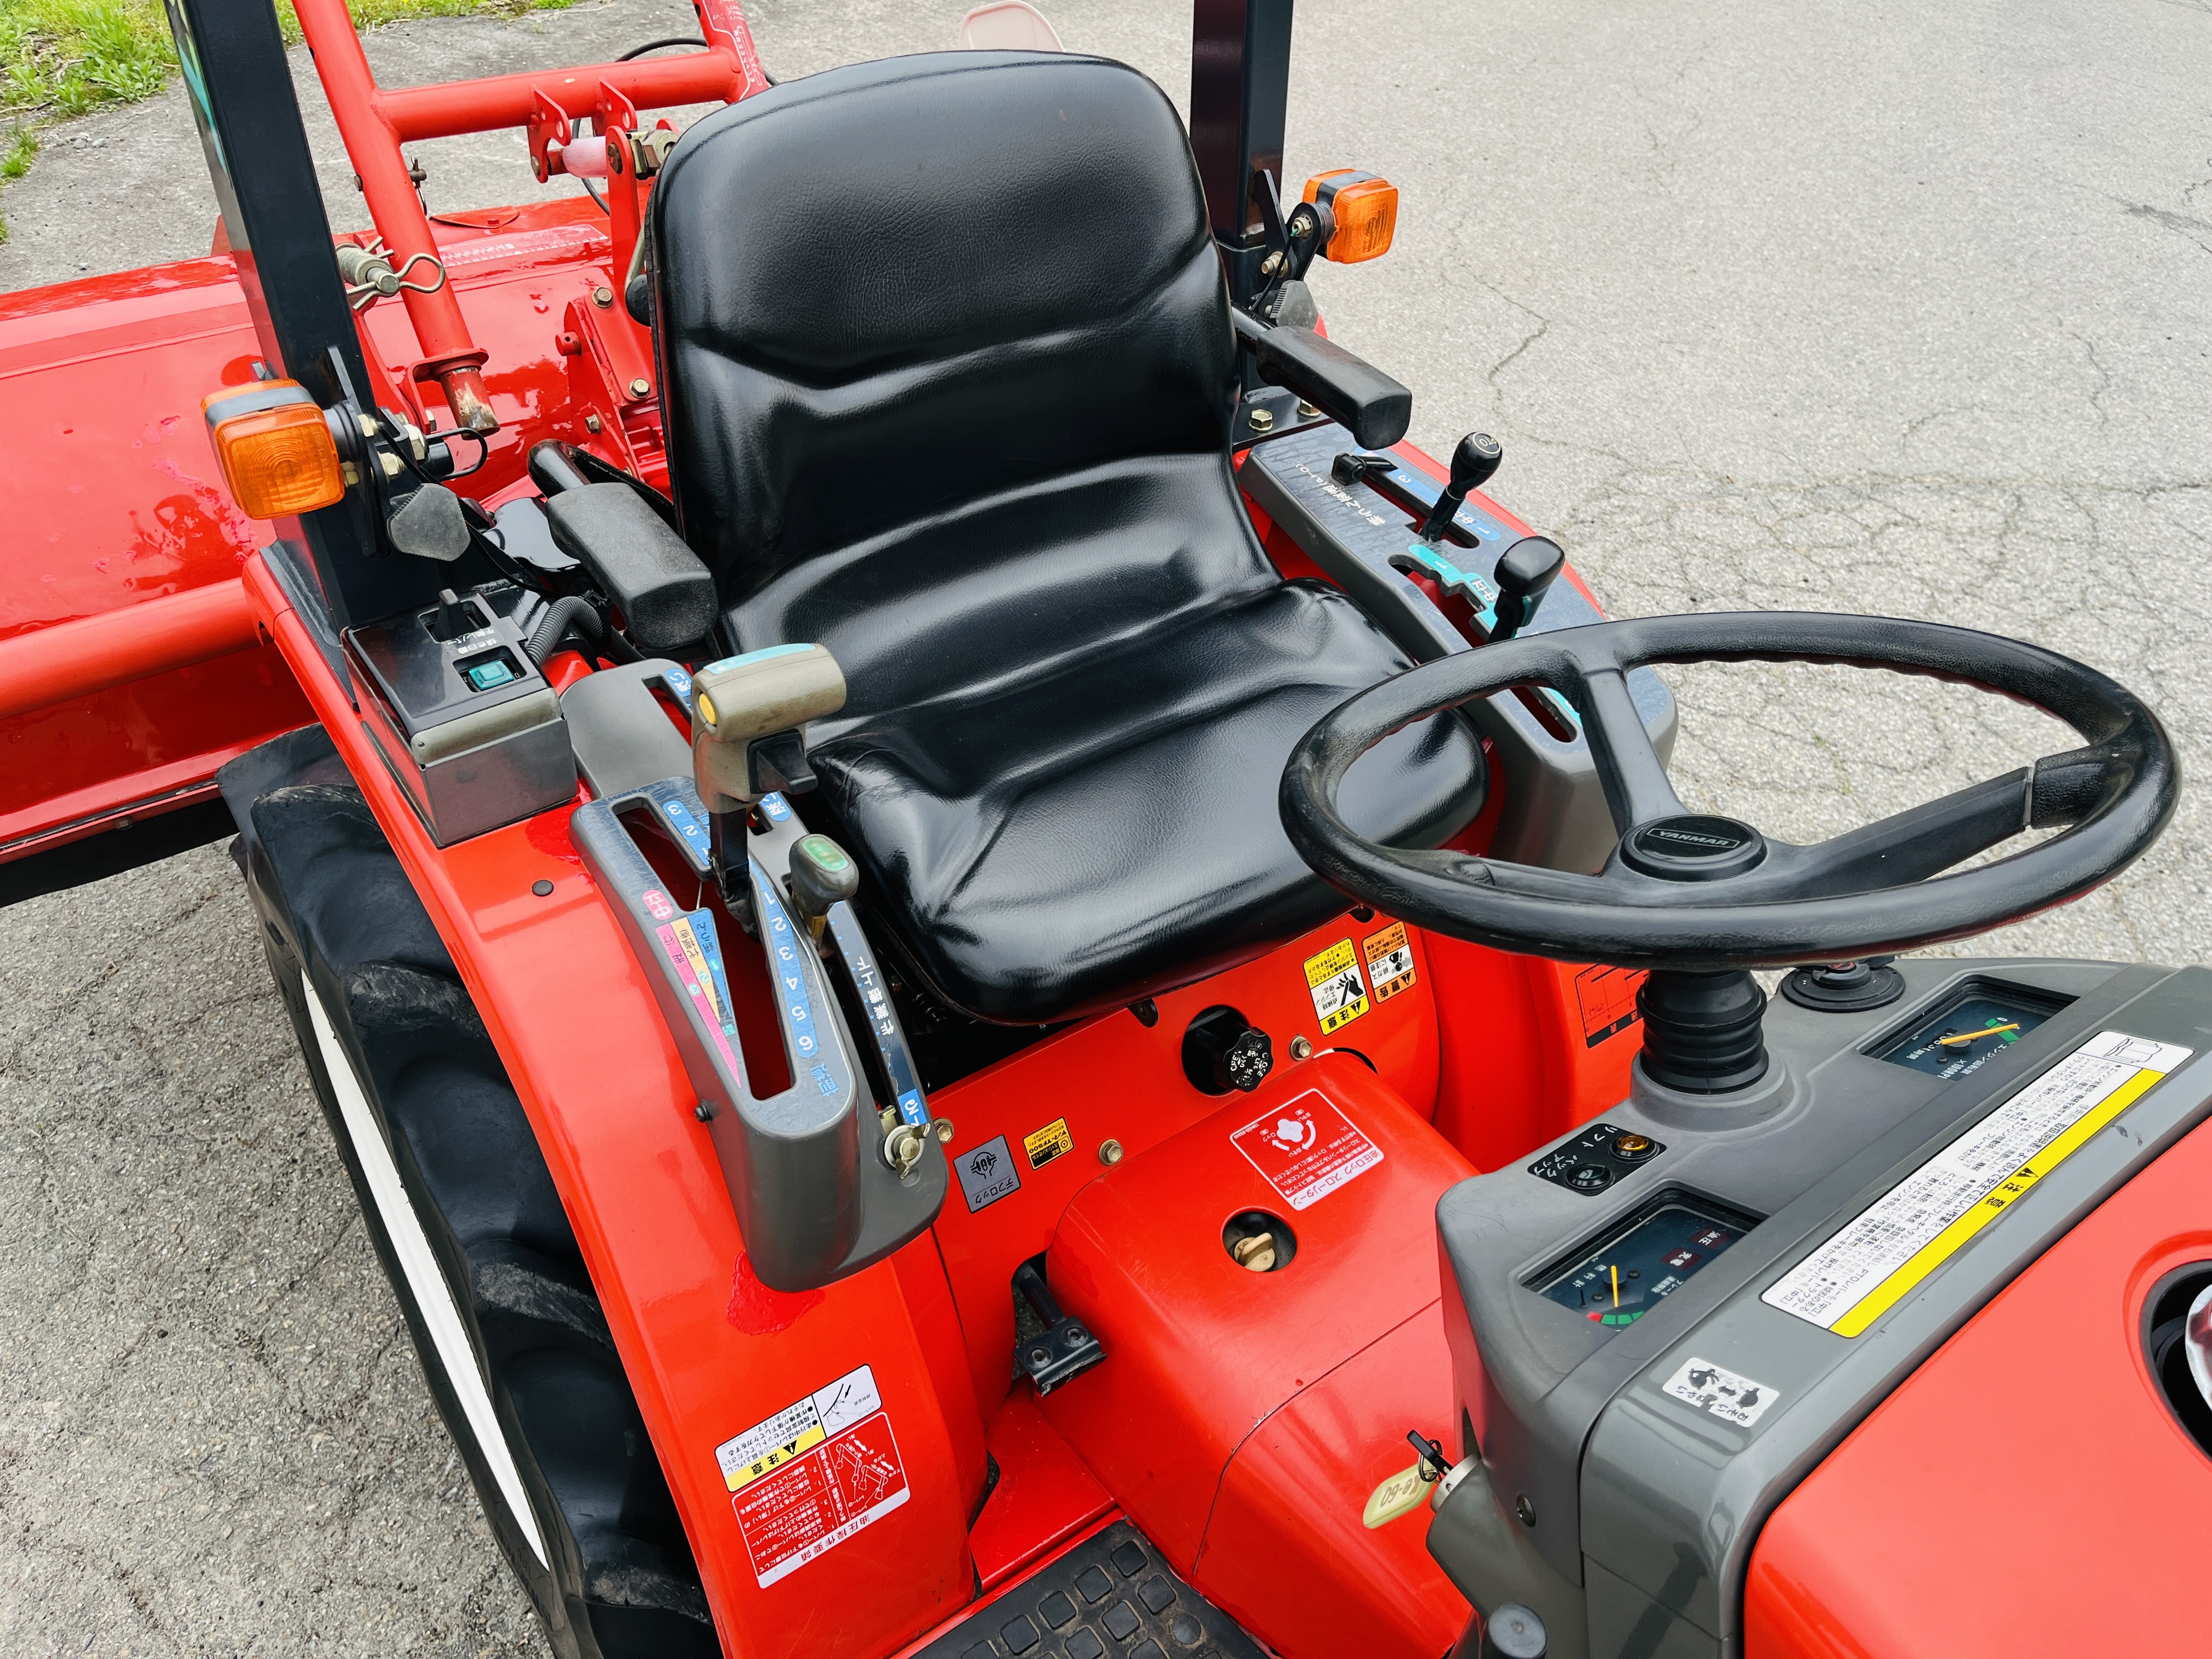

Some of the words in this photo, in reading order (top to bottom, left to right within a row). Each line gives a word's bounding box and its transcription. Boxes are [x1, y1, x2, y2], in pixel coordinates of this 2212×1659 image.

[1479, 436, 1497, 447] PTO
[668, 804, 682, 815] 3
[682, 825, 698, 836] 2
[1659, 830, 1730, 847] YANMAR
[644, 892, 671, 918] 中立
[764, 892, 775, 905] 1
[771, 917, 787, 931] 2
[778, 946, 794, 961] 3
[1369, 958, 1386, 972] に注意
[785, 977, 798, 990] 4
[1323, 984, 1334, 995] 停止
[1379, 979, 1400, 1000] 警告
[857, 956, 894, 1036] 作業機上下
[1315, 991, 1335, 1006] エンジン
[791, 1006, 807, 1021] 5
[1327, 1008, 1350, 1029] 注意
[798, 1036, 814, 1051] 6
[810, 1063, 839, 1097] 前進
[1261, 1131, 1277, 1142] ロック
[1577, 1125, 1620, 1149] リフト
[1028, 1138, 1052, 1154] TF500
[1286, 1147, 1302, 1158] おそい
[1527, 1153, 1566, 1175] アップ
[1540, 1154, 1583, 1178] バック
[974, 1177, 1013, 1205] デフロック
[1983, 1182, 2025, 1209] 注意
[1696, 1231, 1722, 1246] 油圧
[1667, 1251, 1694, 1267] 充電
[751, 1452, 780, 1476] 注意
[799, 1512, 870, 1564] 油圧操作要領
